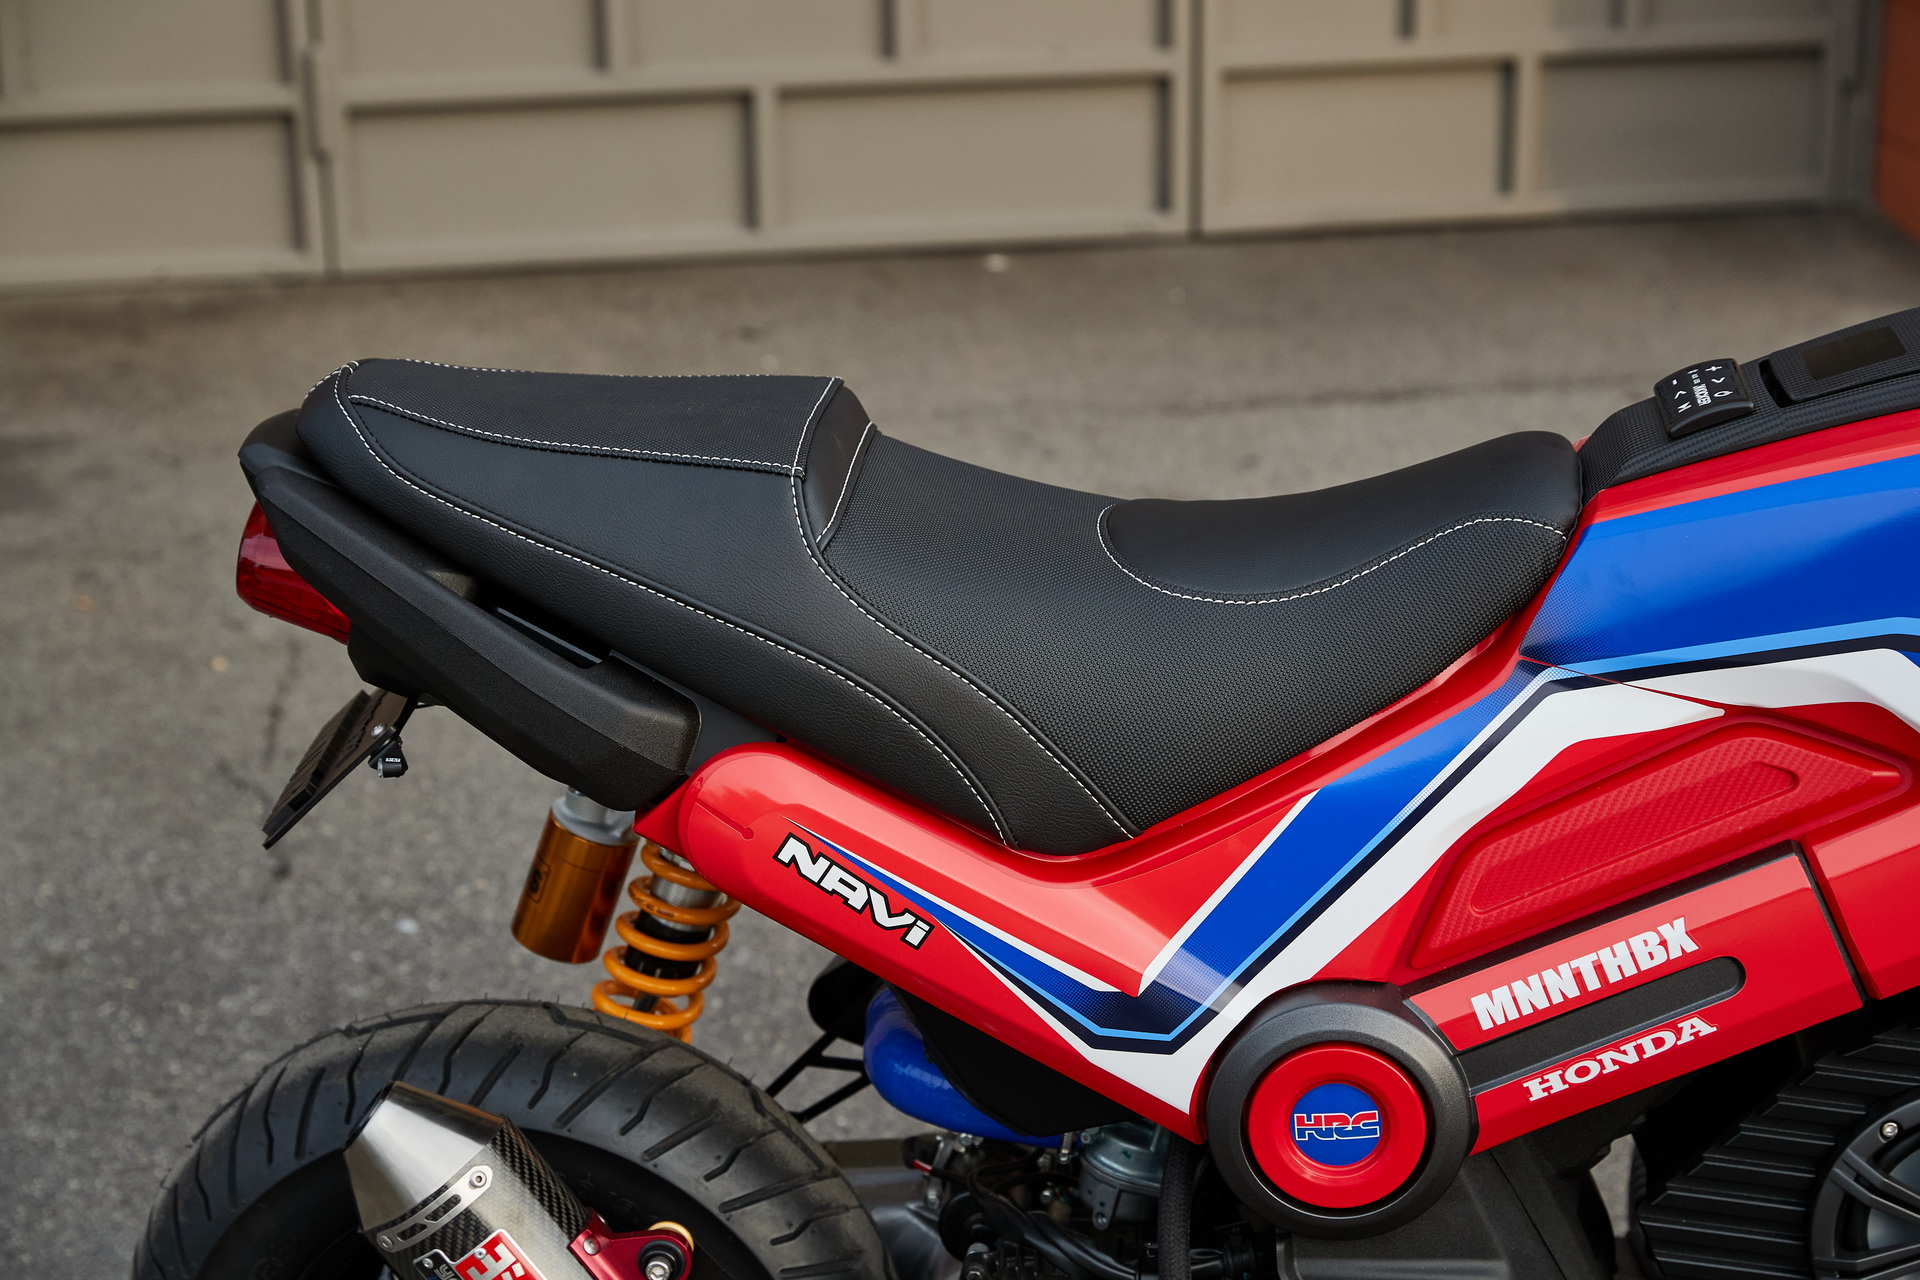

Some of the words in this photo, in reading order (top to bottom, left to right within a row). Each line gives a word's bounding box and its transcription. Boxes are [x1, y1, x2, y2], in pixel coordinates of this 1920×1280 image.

[1470, 917, 1699, 1031] MNNTHBX
[1522, 1016, 1717, 1102] HONDA
[1294, 1110, 1380, 1141] HRC
